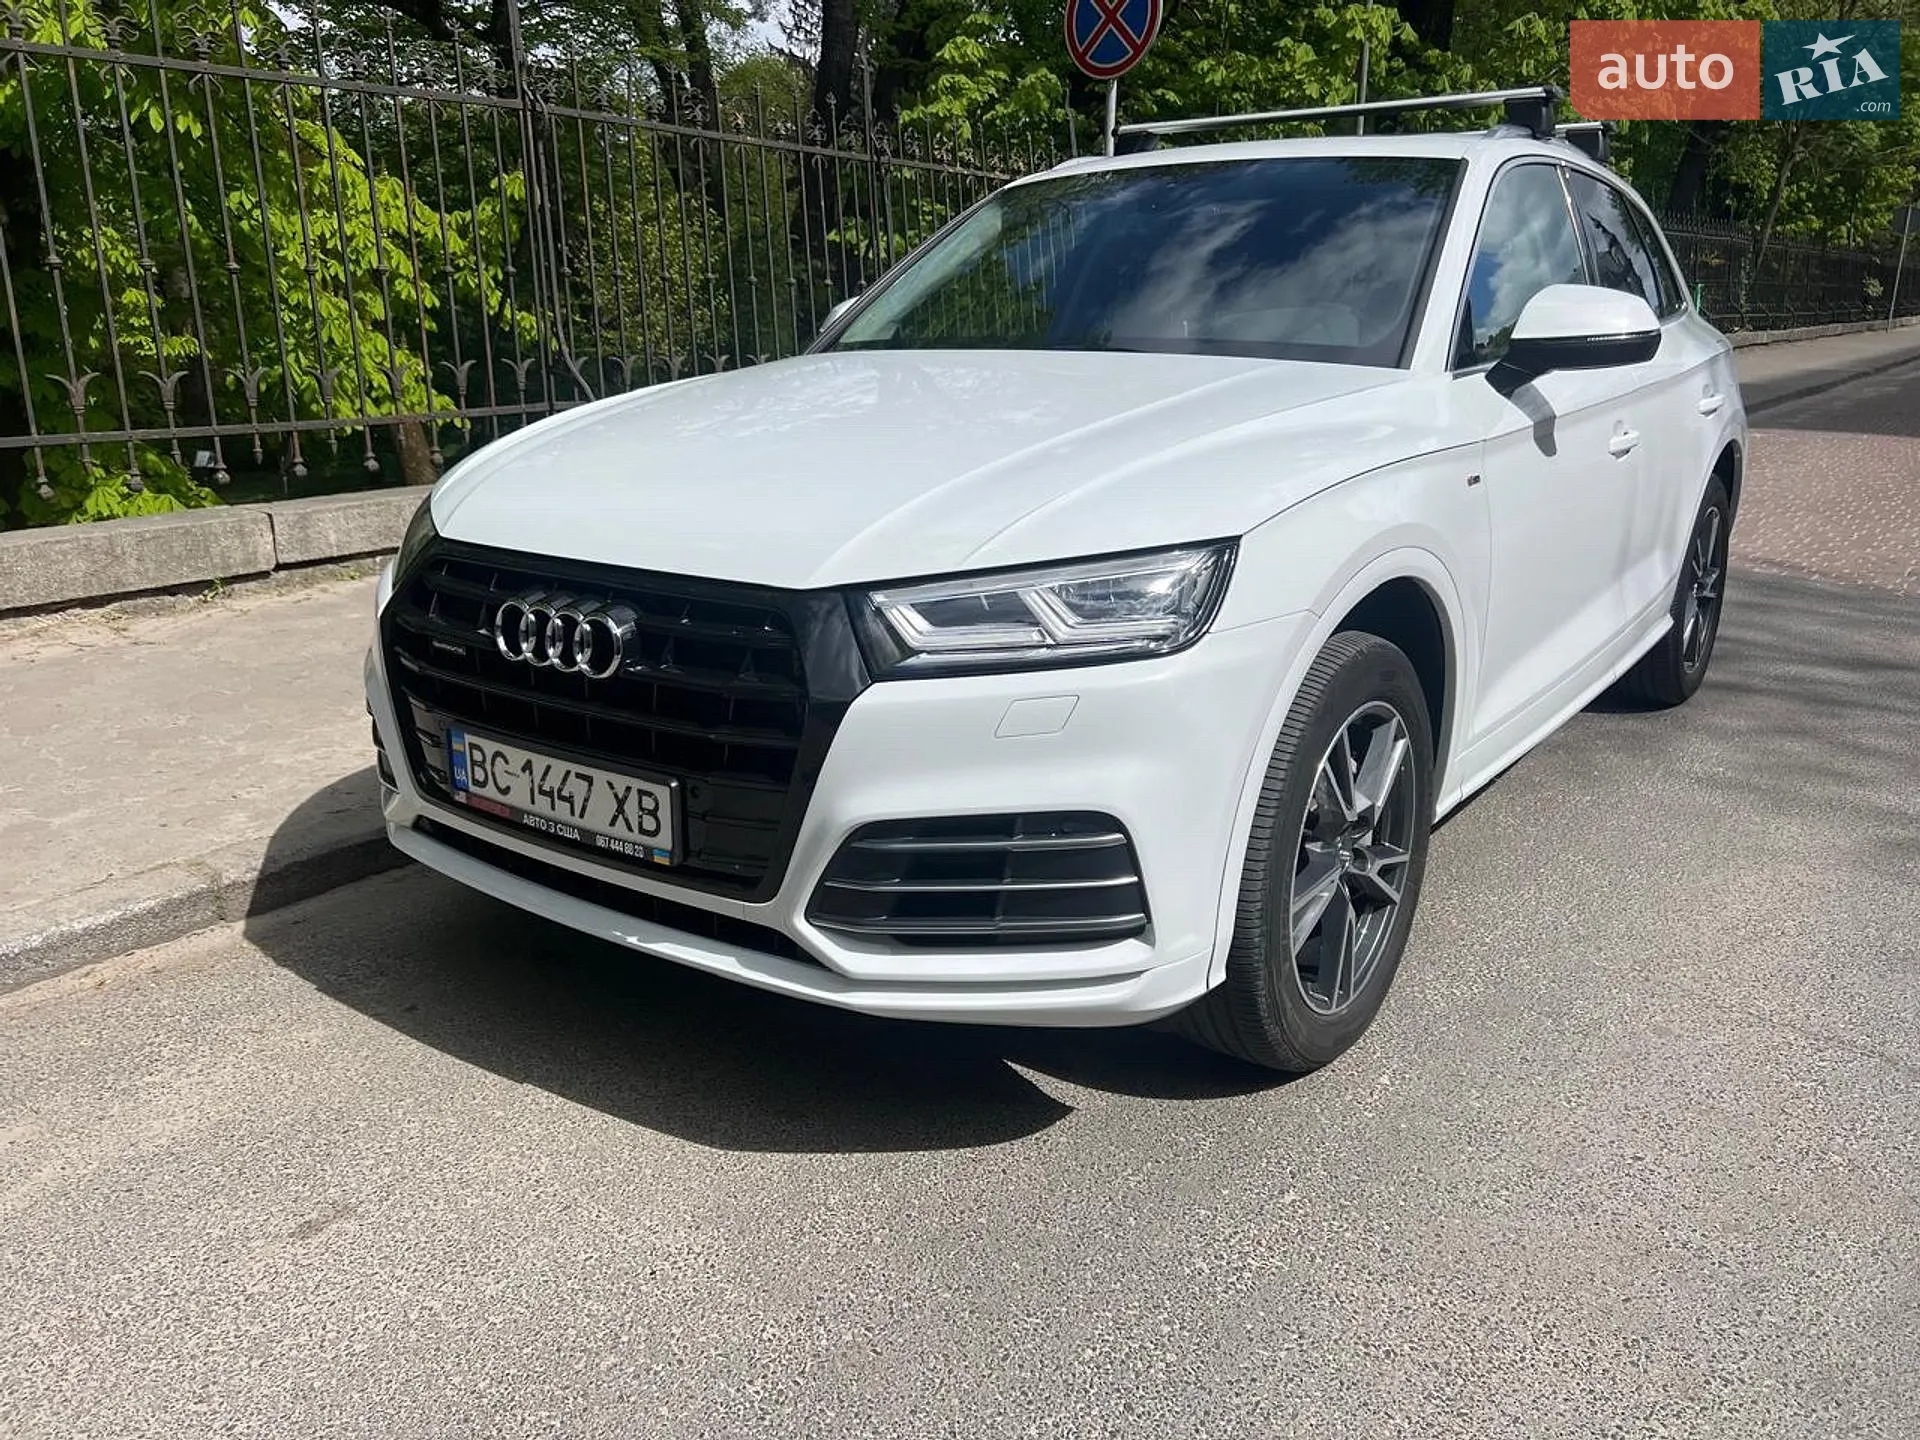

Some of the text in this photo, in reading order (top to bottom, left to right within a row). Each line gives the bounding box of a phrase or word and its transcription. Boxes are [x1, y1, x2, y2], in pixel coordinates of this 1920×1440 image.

[454, 766, 467, 783] UA
[521, 758, 593, 819] 1447
[606, 780, 661, 837] XB
[523, 813, 547, 830] АВТО
[557, 825, 580, 841] США
